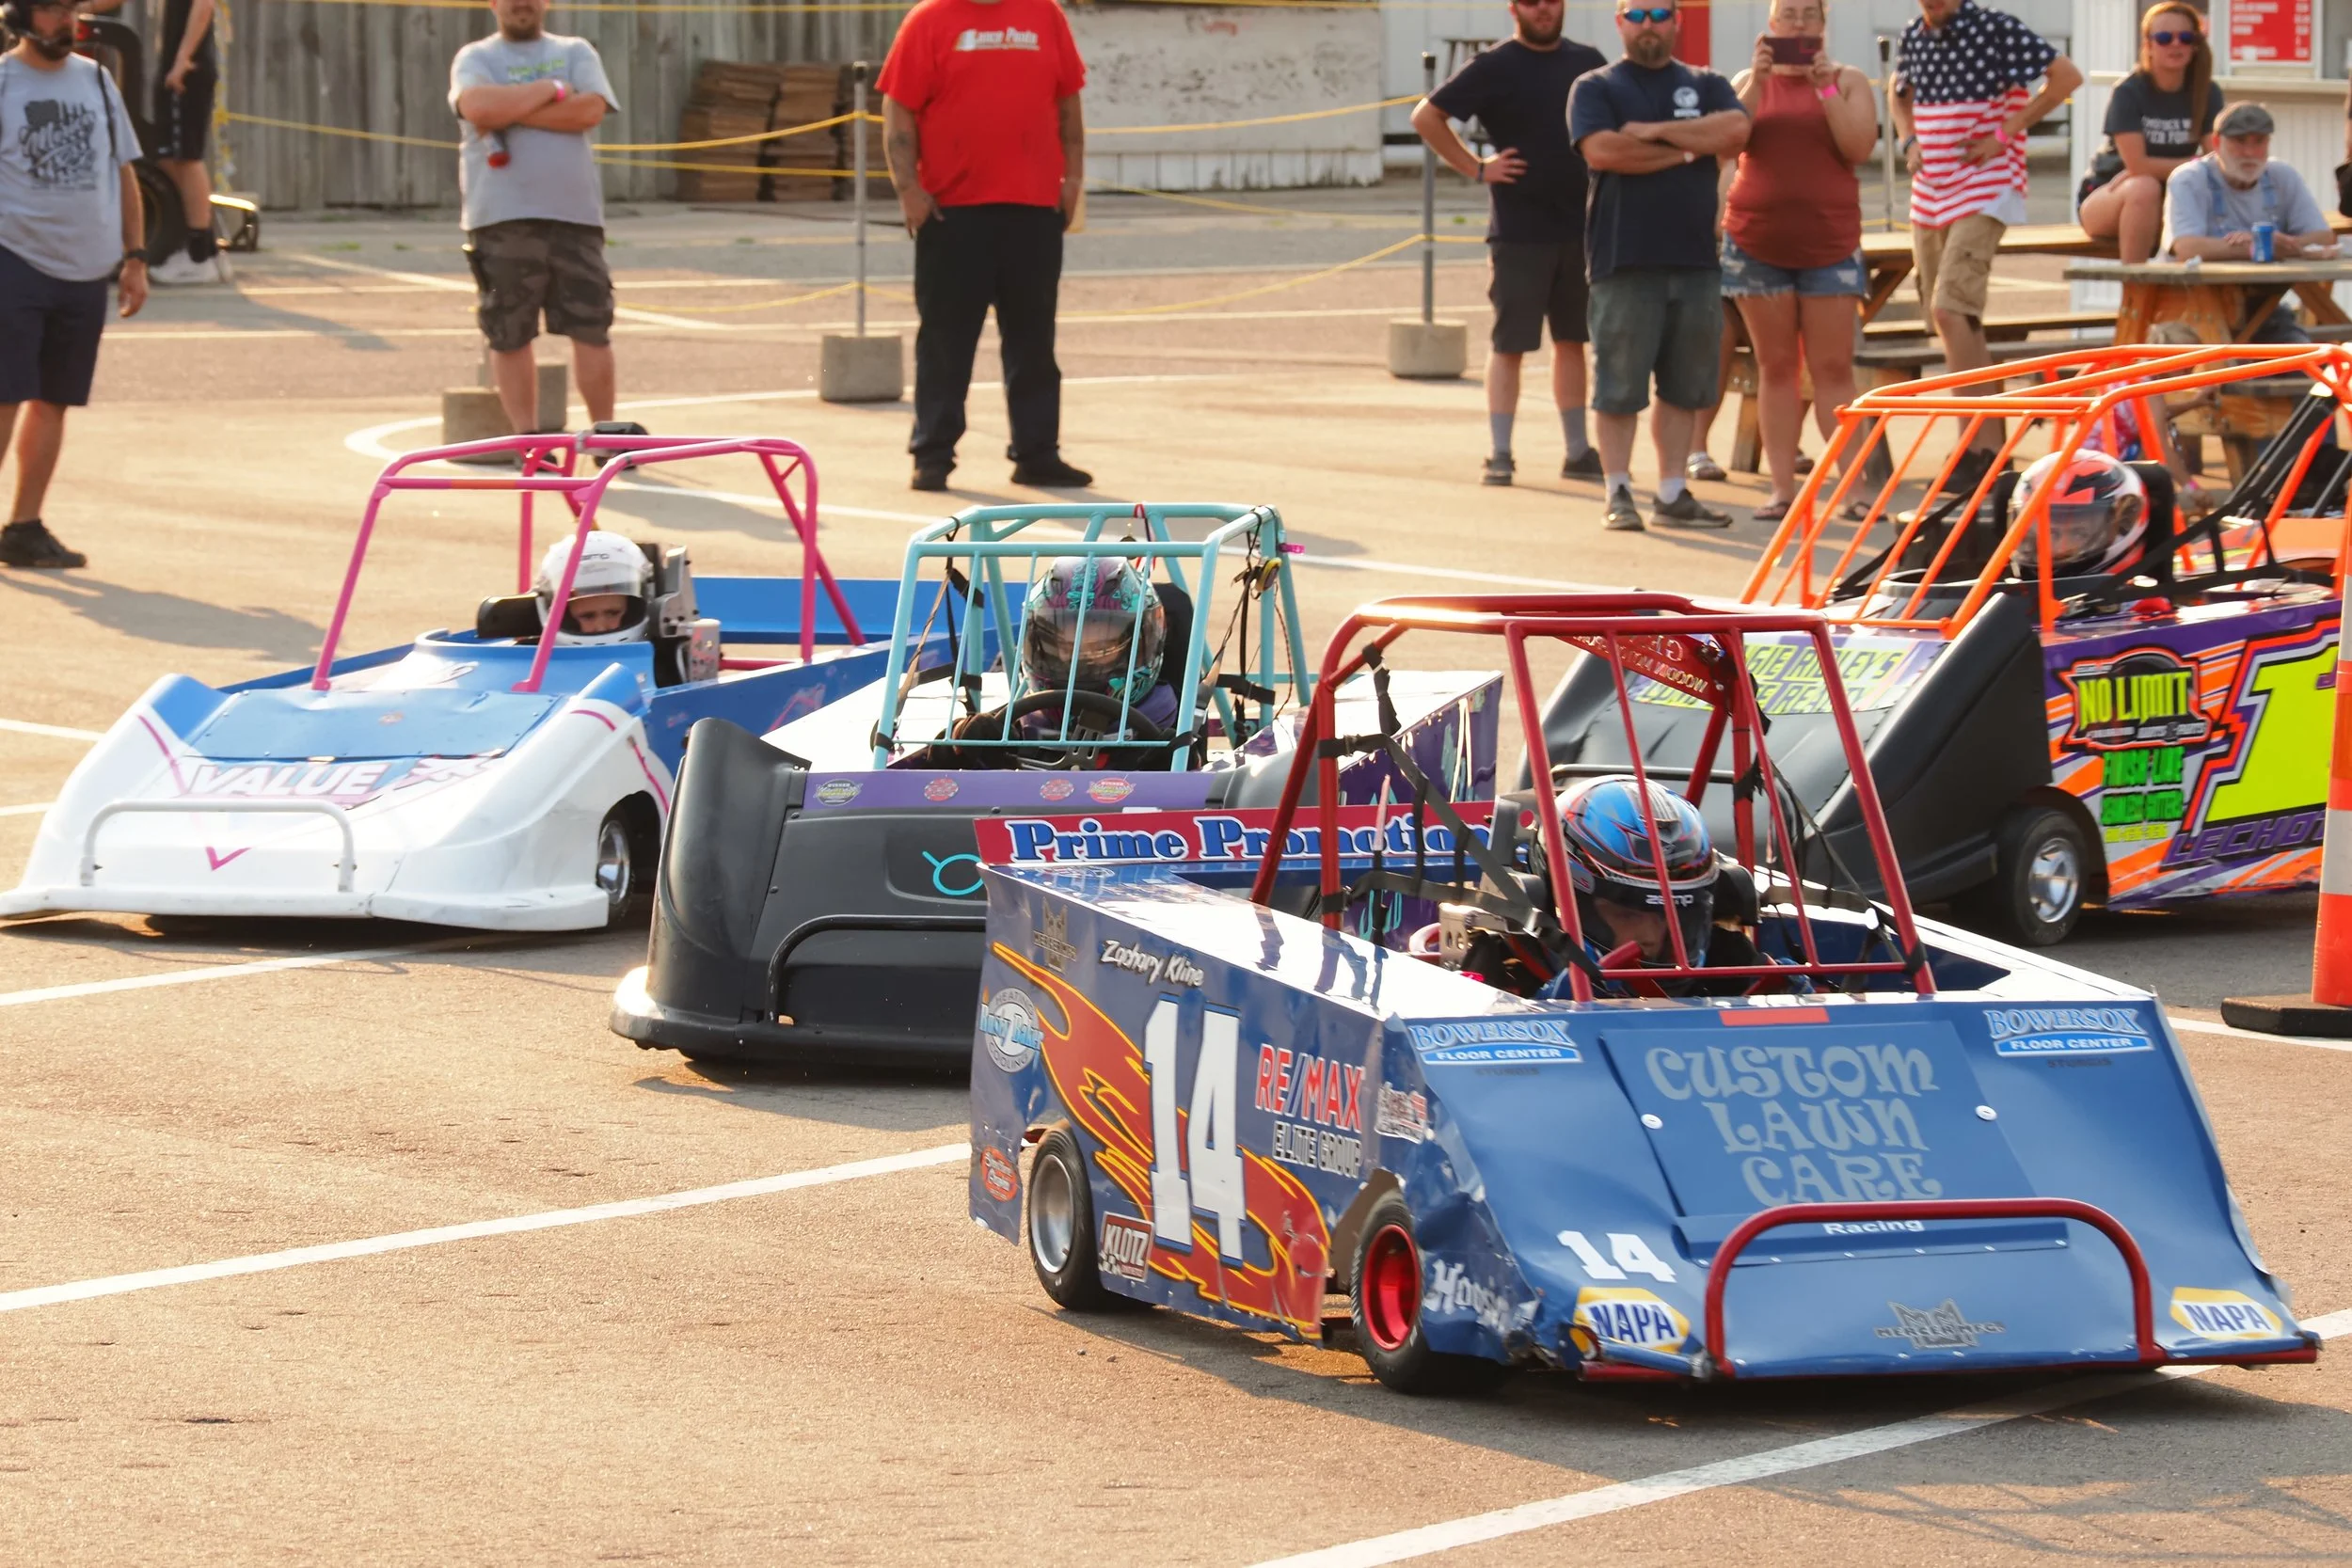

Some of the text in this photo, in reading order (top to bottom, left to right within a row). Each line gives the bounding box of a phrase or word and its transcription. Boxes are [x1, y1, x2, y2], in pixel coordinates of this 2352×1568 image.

[2077, 671, 2192, 731] NO LIMIT
[187, 763, 389, 796] VALUE
[1004, 810, 1528, 863] Prime Promotio
[1164, 951, 1205, 988] Kline
[1409, 1019, 1578, 1051] BOWERSOX
[1983, 1007, 2148, 1039] BOWERSOX
[2010, 1037, 2134, 1051] FLOOR CENTER
[1436, 1047, 1563, 1061] FLOOR CENTER
[1645, 1043, 1940, 1101] CUSTOM
[1254, 1043, 1366, 1133] RE/MAX
[1143, 992, 1247, 1268] 14
[1272, 1120, 1318, 1168] ELITE
[1701, 1098, 1930, 1154] LAWN
[1741, 1152, 1944, 1208] CARE
[1103, 1223, 1150, 1267] KLOTZ
[1821, 1220, 1925, 1235] Racing
[1556, 1229, 1677, 1284] 14
[1587, 1303, 1677, 1343] NAPA
[2183, 1301, 2266, 1334] NAPA
